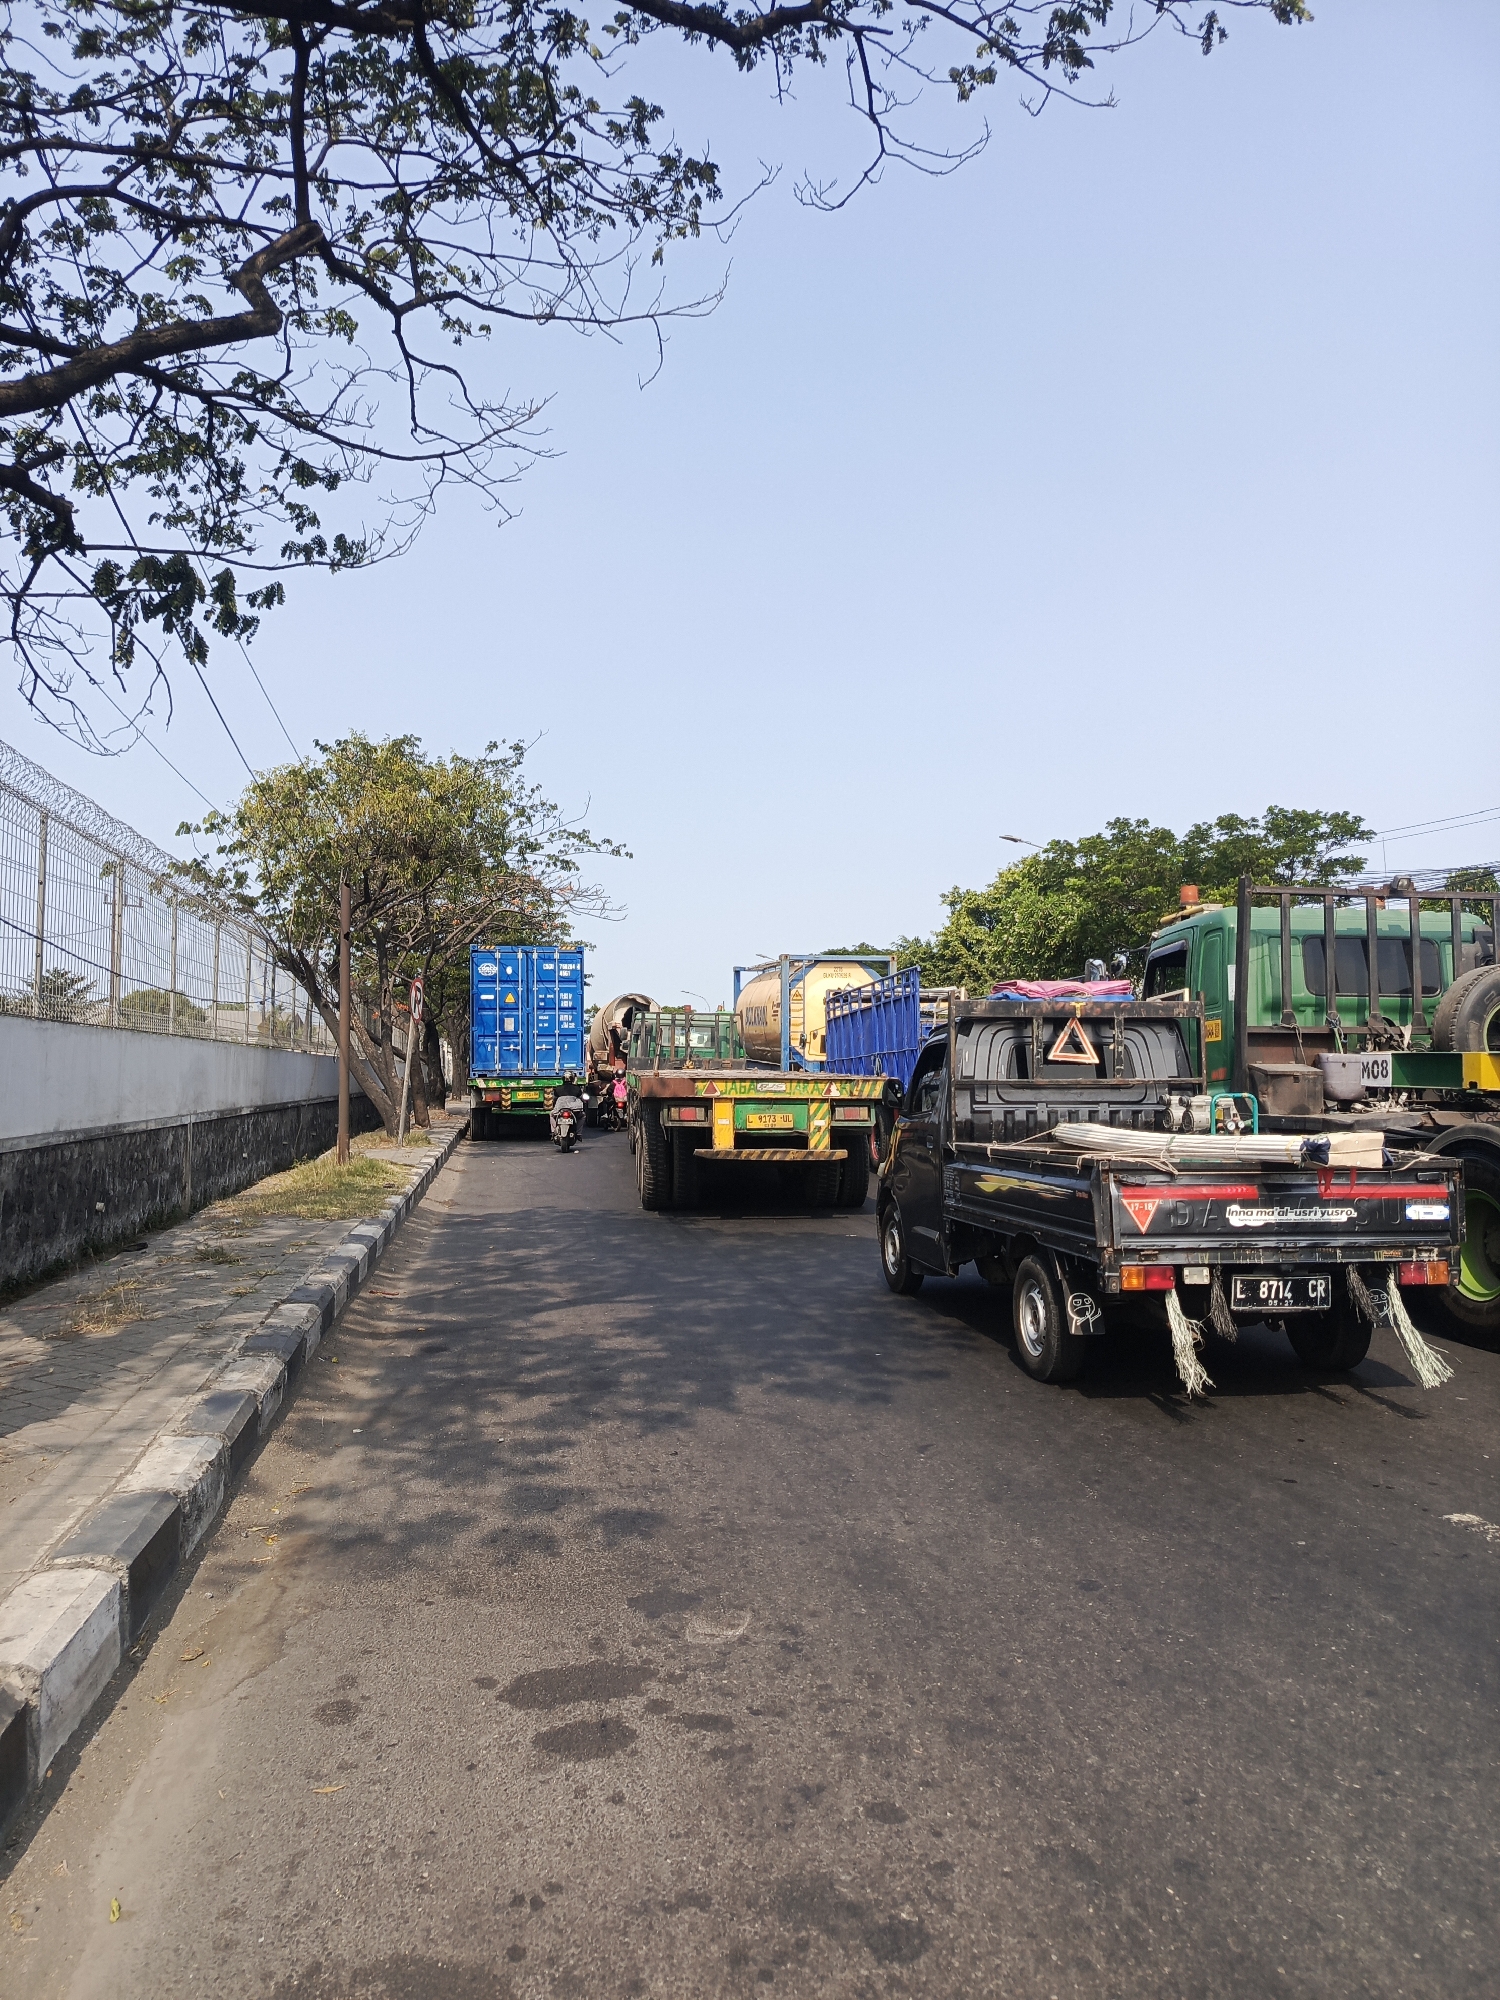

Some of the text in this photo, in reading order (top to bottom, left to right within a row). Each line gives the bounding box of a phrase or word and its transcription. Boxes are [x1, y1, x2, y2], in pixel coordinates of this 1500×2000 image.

[720, 1079, 757, 1096] JAGA
[747, 1114, 792, 1123] L 9173 UL
[1227, 1207, 1254, 1217] Inna
[1236, 1280, 1326, 1299] L 8714 CR
